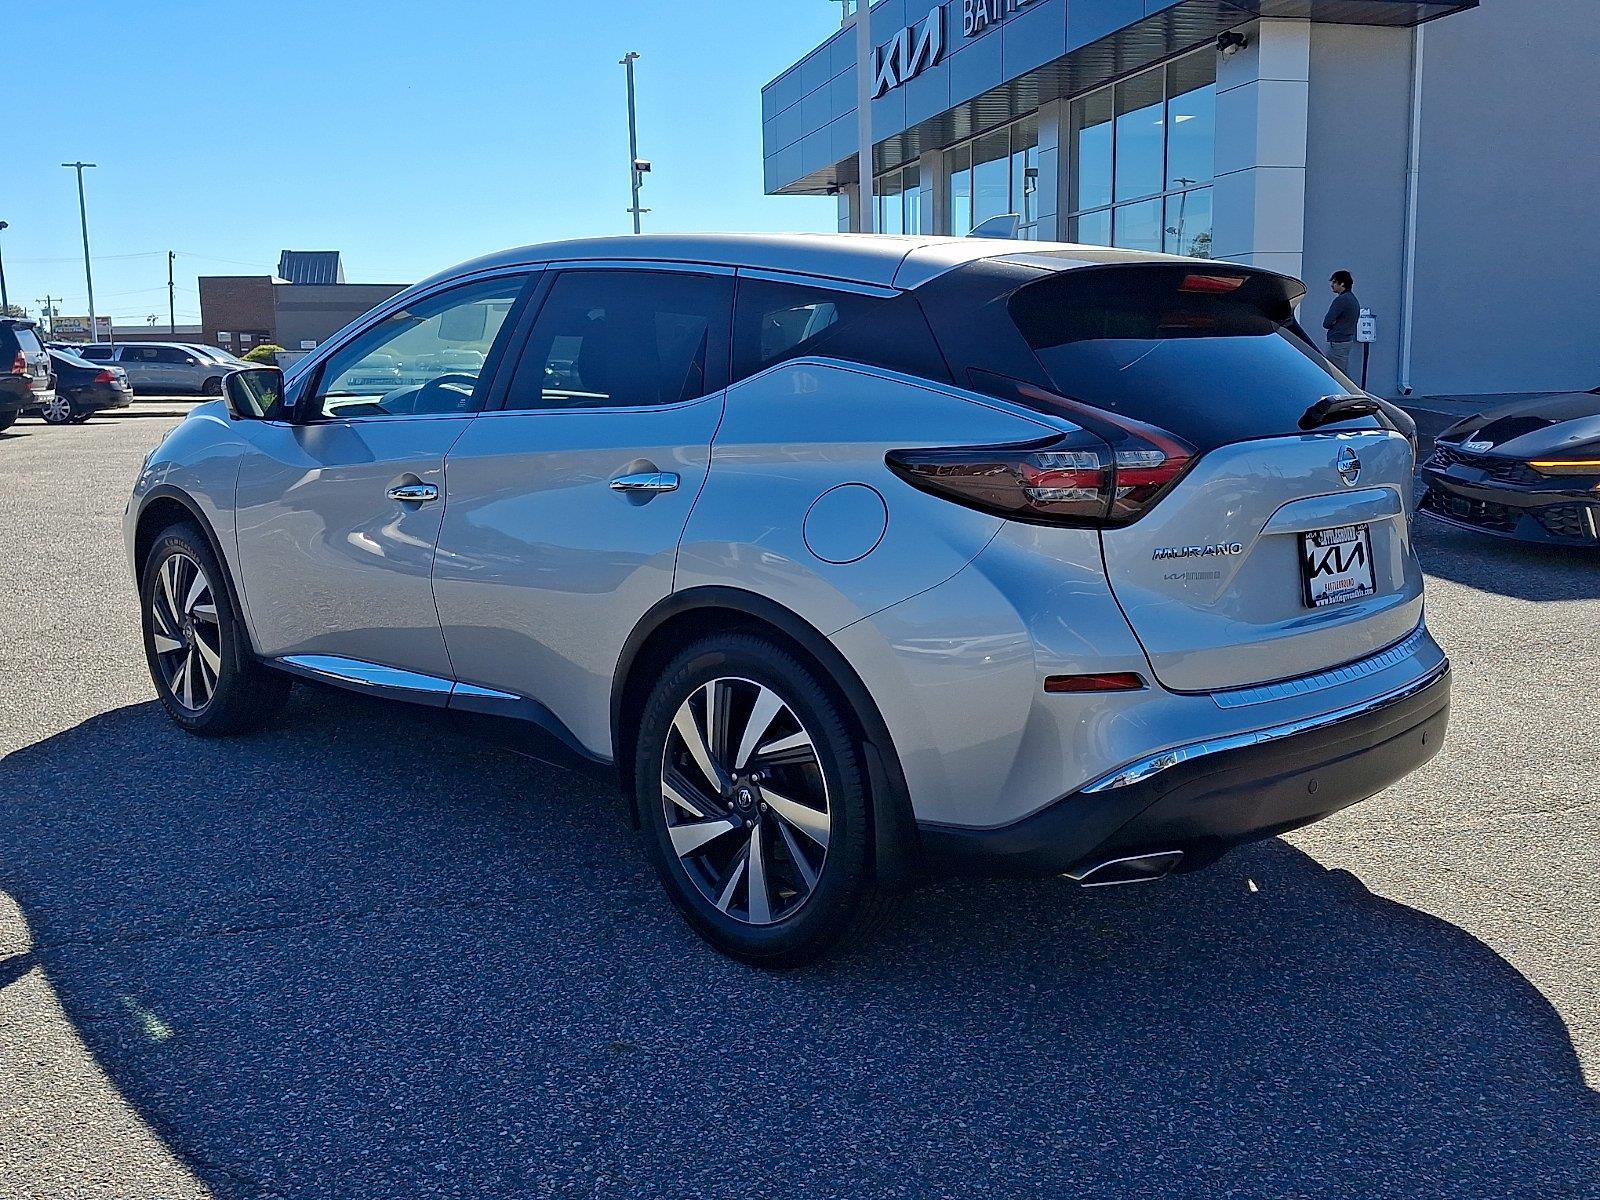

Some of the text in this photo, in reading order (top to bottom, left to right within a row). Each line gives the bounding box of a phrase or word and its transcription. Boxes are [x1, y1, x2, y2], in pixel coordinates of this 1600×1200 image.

[870, 5, 942, 100] KIA
[1152, 542, 1243, 560] MURANO
[1308, 541, 1365, 579] KIA
